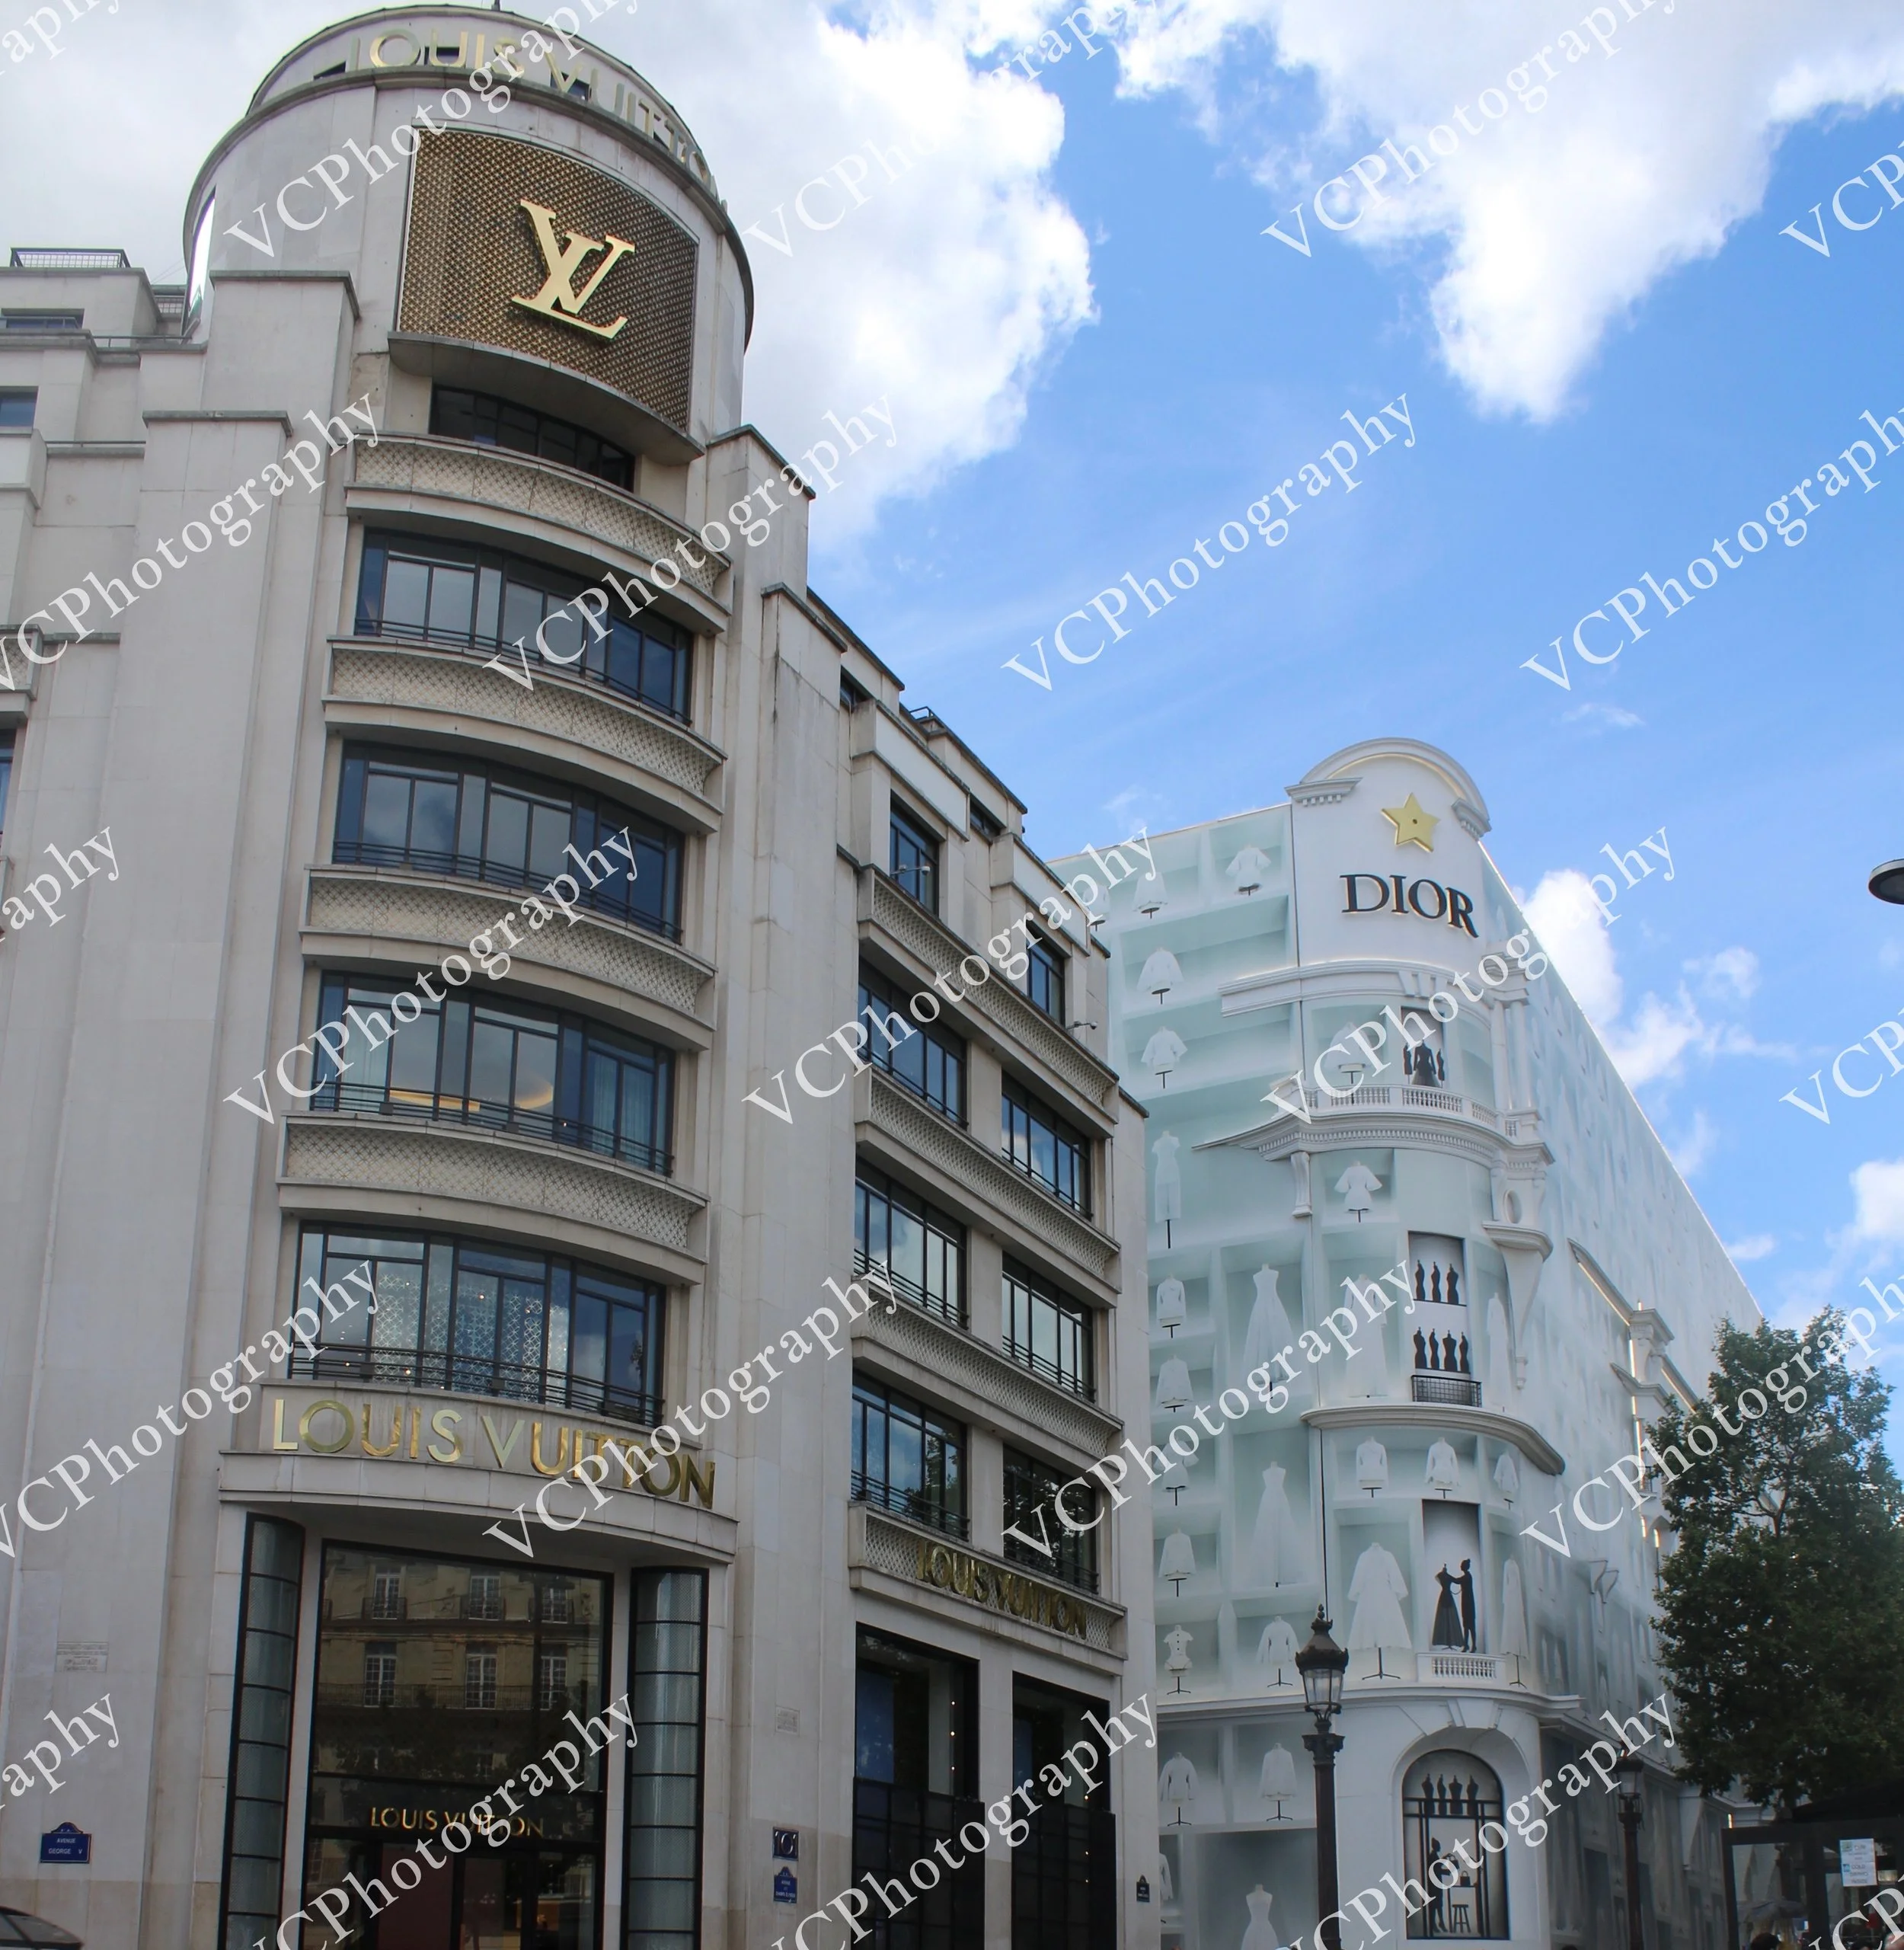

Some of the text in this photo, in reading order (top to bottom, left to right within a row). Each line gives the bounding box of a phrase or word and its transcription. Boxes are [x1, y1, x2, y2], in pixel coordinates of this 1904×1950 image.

[1339, 874, 1479, 938] DIOR
[273, 1399, 715, 1509] LOUIS VUITTON
[370, 1808, 437, 1830] LOUIS
